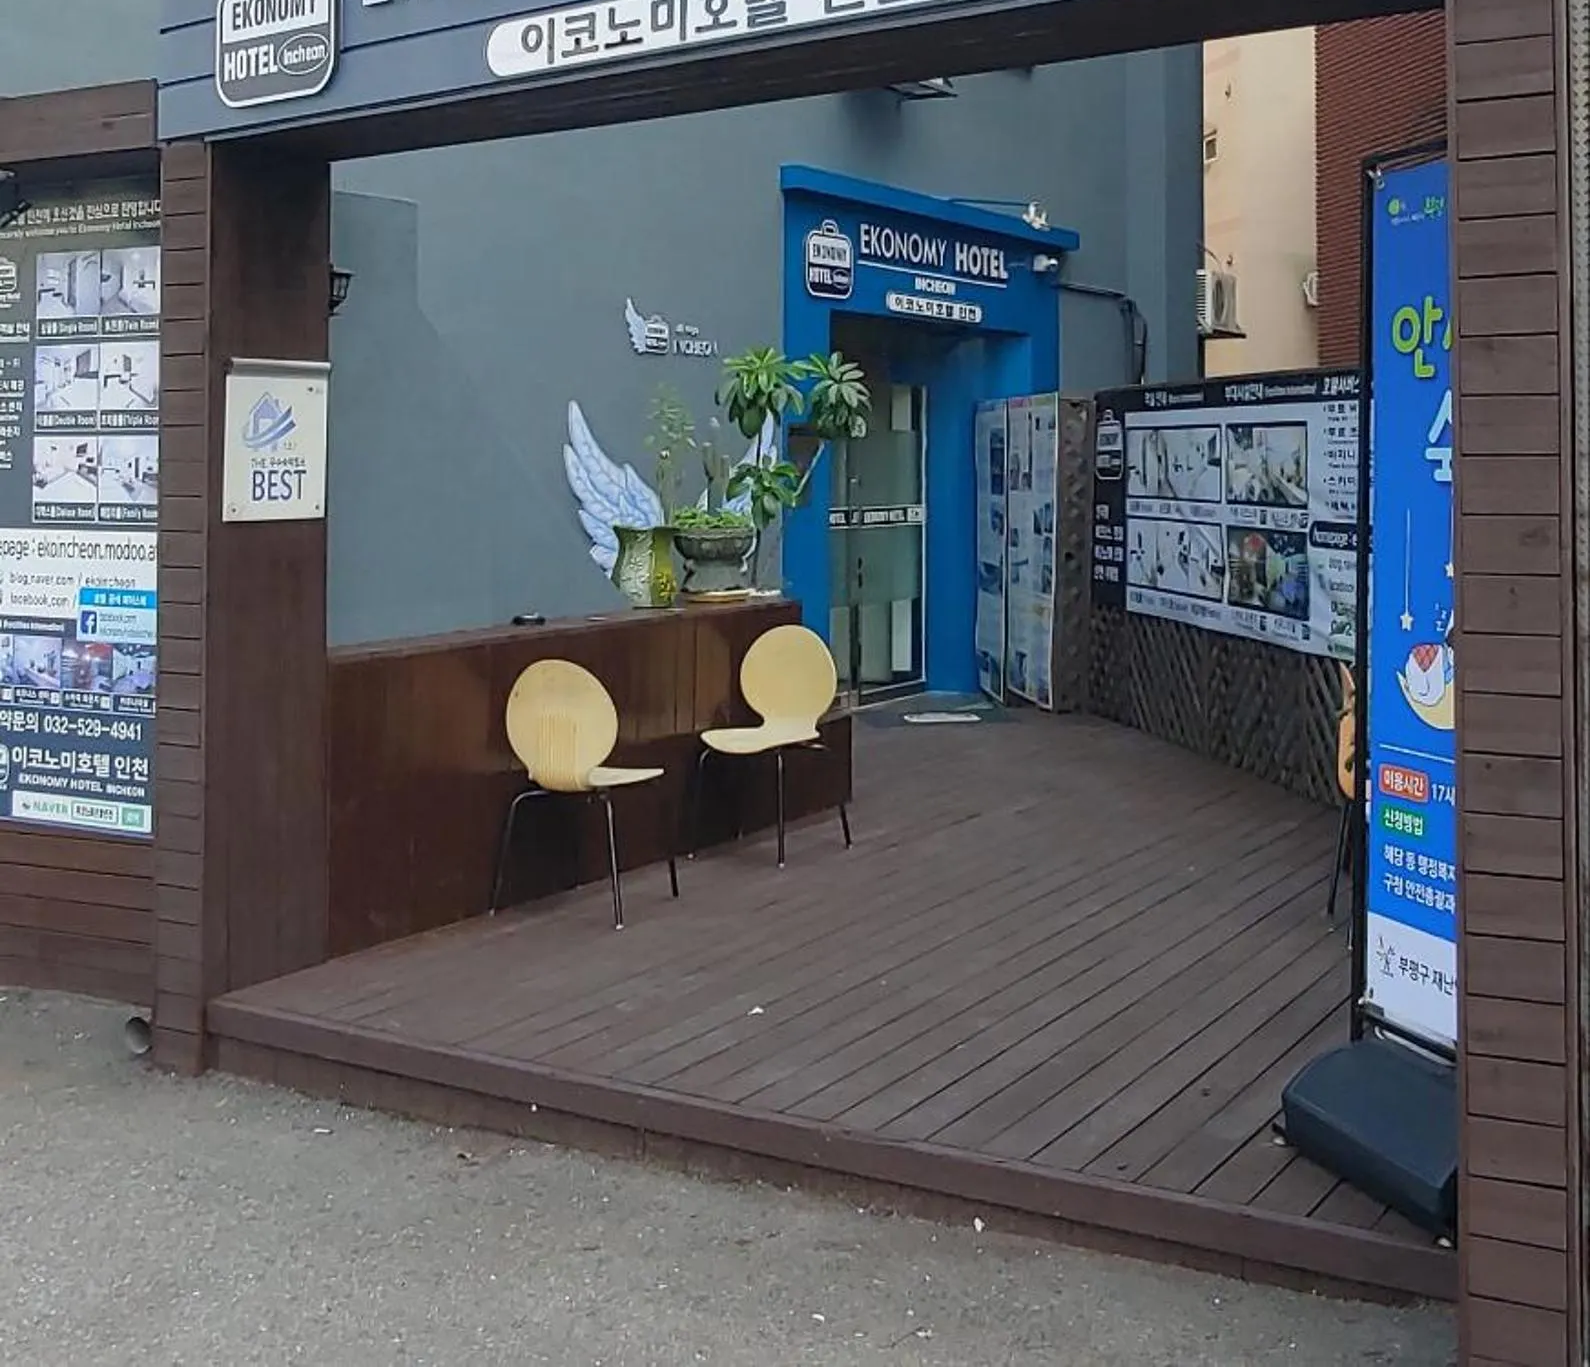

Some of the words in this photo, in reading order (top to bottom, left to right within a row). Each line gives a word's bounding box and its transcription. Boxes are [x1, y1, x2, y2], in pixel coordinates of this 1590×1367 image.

[223, 43, 278, 83] HOTEL
[859, 223, 947, 267] EKONOMY
[955, 241, 1009, 279] HOTEL
[252, 470, 307, 502] BEST
[12, 746, 110, 778] 이코노미호텔
[114, 756, 149, 782] 인천
[69, 778, 103, 793] HOTEL
[1383, 769, 1424, 797] 이용시간
[1383, 808, 1423, 836] 신청방법
[1398, 956, 1430, 987] 부평구
[1432, 968, 1457, 996] 재난
